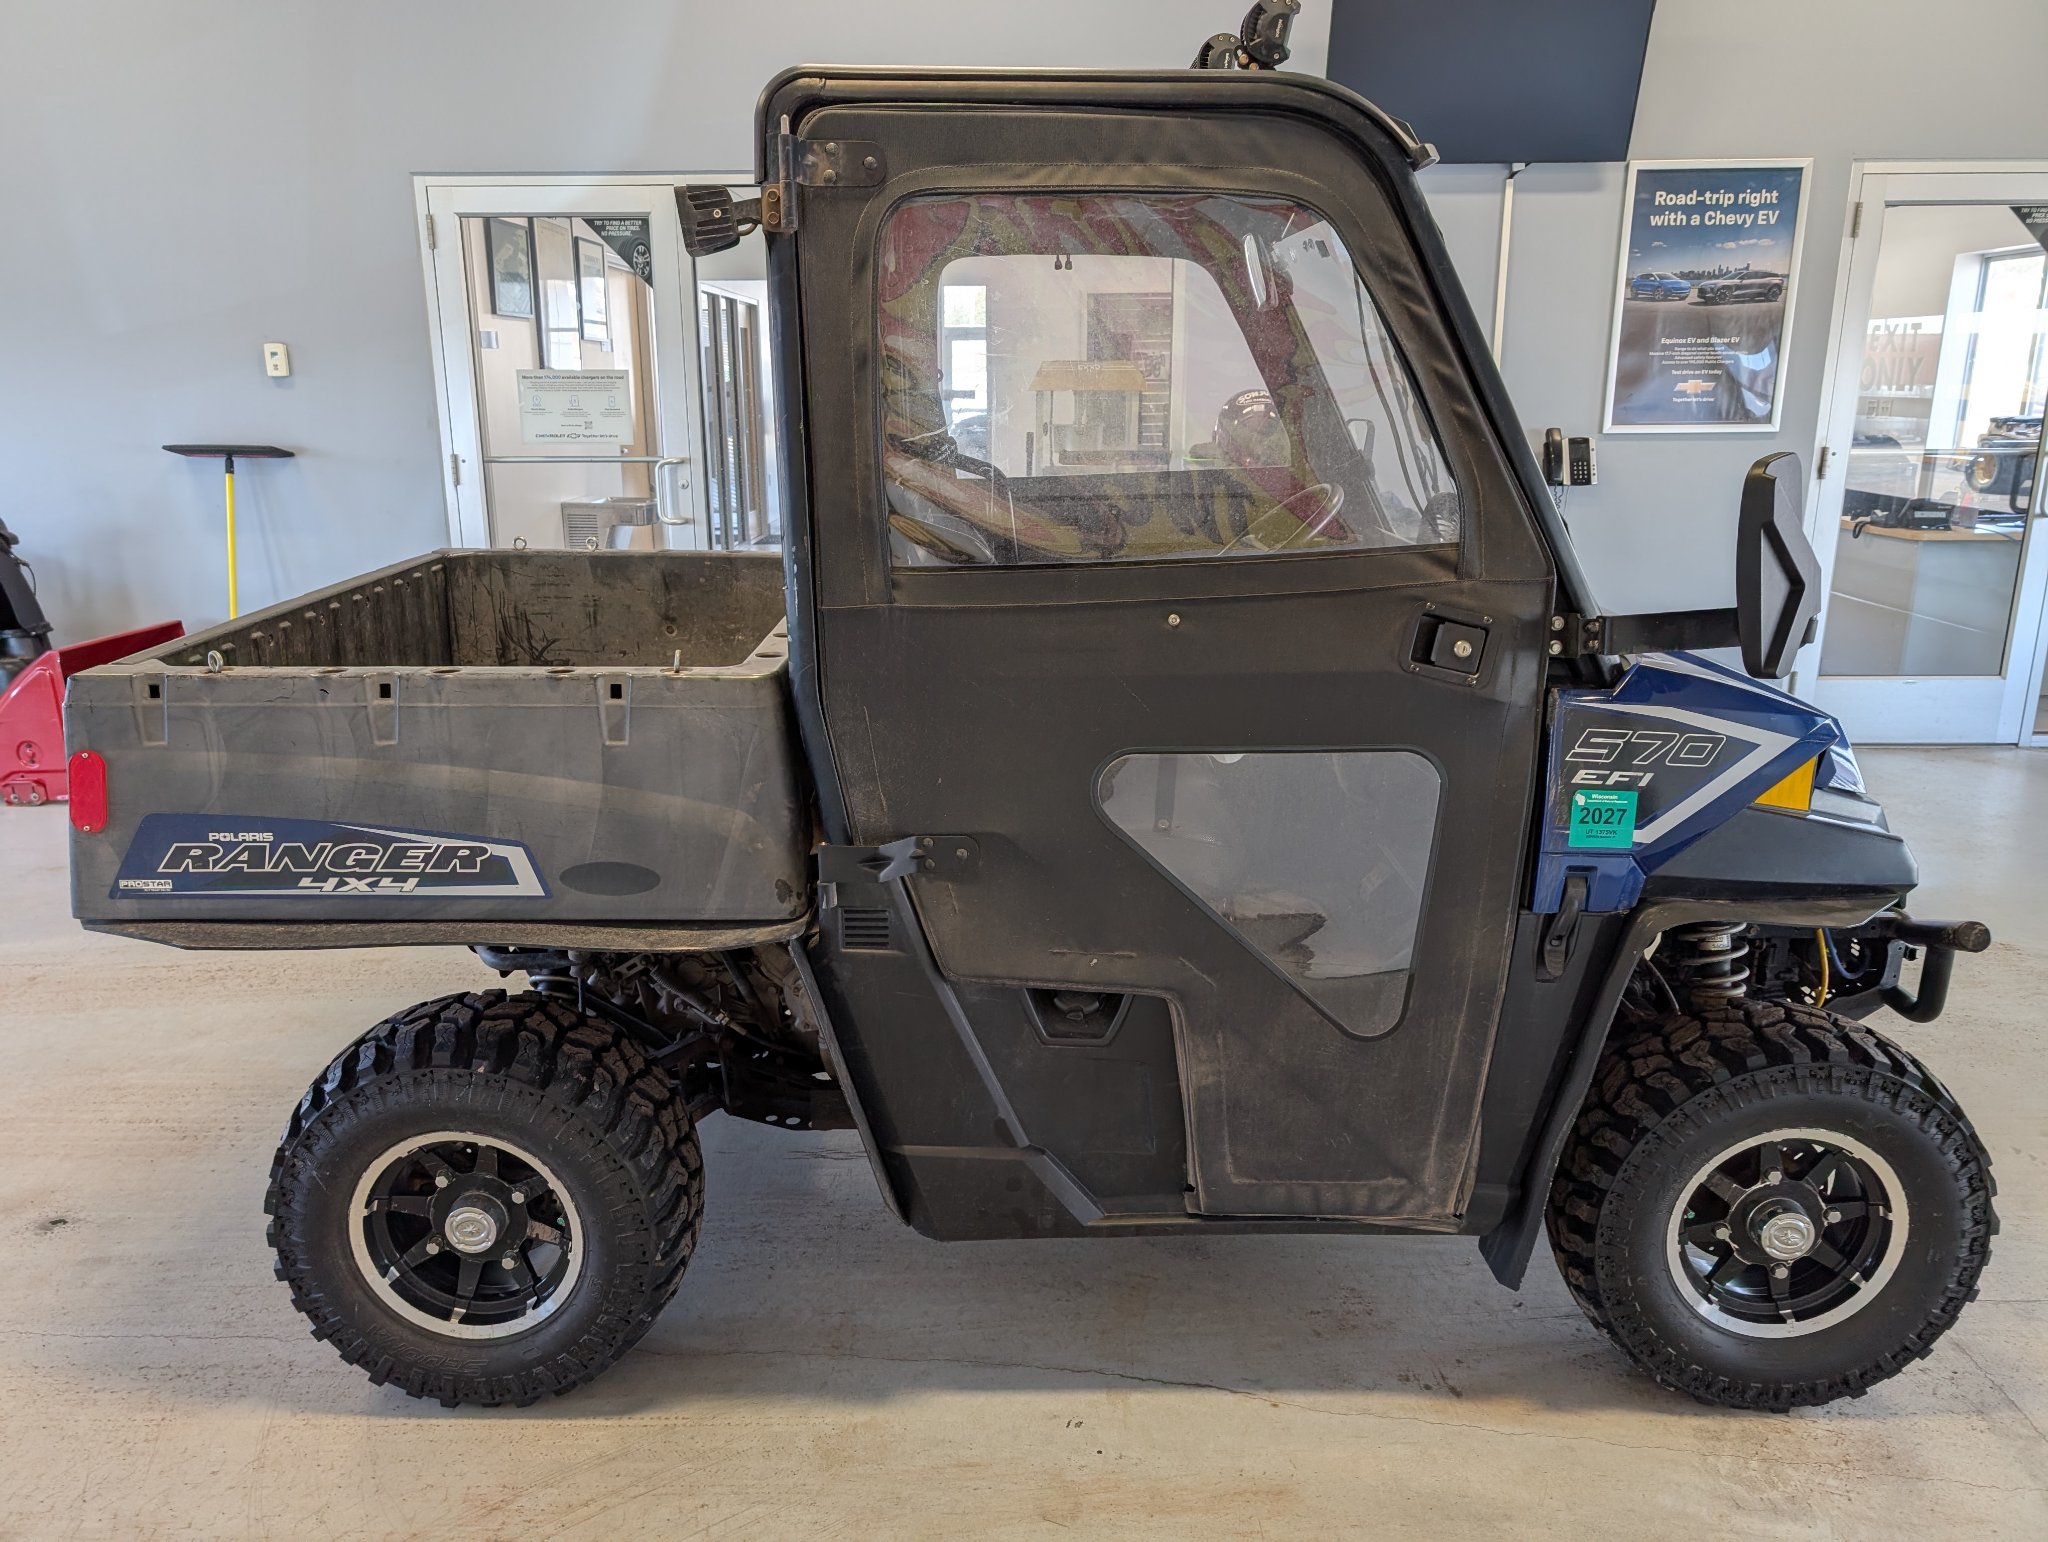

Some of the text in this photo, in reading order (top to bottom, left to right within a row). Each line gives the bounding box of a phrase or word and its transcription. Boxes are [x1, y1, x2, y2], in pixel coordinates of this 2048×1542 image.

[1654, 189, 1779, 208] Road-trip right
[1649, 210, 1780, 228] with a Chevy EV
[1870, 322, 1923, 353] EXIT
[1860, 356, 1925, 392] ONLY
[1565, 728, 1727, 767] 570
[1570, 769, 1655, 787] EFI
[1578, 806, 1628, 826] 2027
[208, 832, 274, 842] POLARIS
[157, 842, 492, 873] RANGER
[120, 880, 171, 888] PROSTAR
